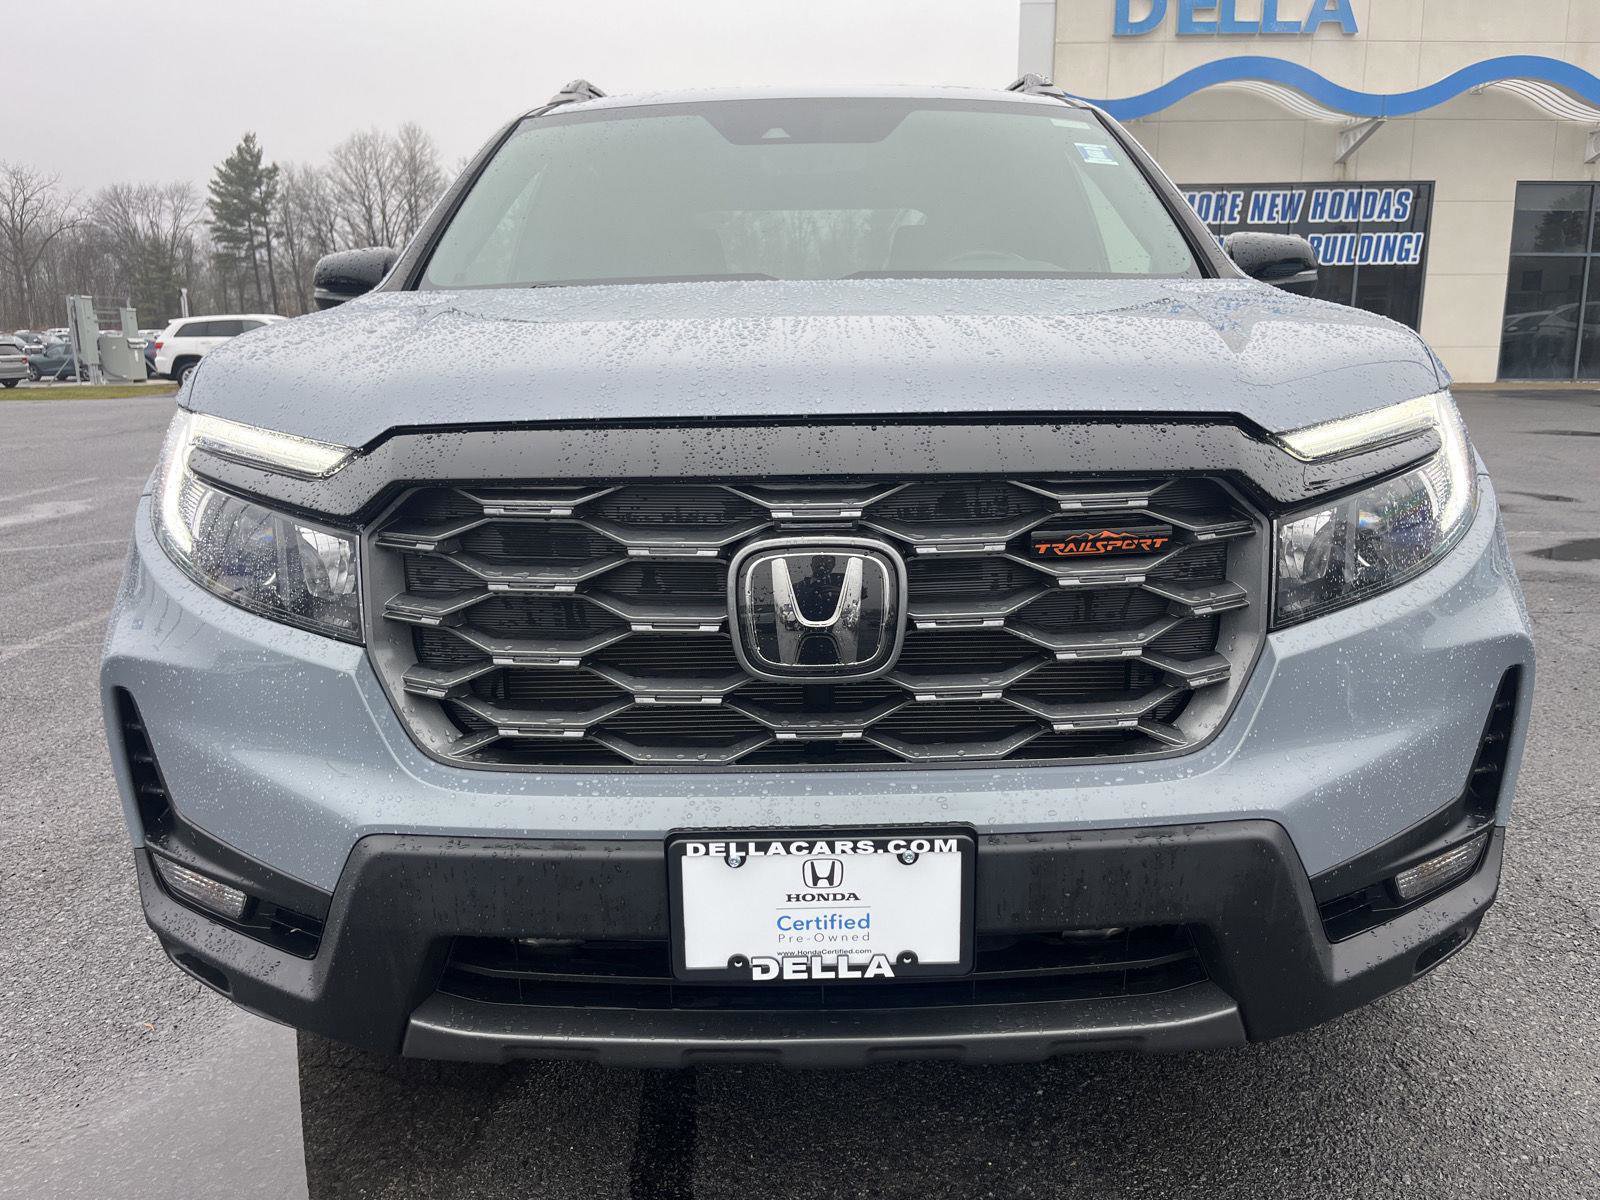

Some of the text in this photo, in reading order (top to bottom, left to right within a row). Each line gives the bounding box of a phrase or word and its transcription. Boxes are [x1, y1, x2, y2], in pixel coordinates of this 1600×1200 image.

[1112, 0, 1359, 37] DELLA
[1247, 190, 1306, 224] NEW
[1308, 188, 1412, 223] HONDAS
[1034, 538, 1168, 555] TRAILSPORT
[686, 839, 958, 857] DELLACARS.COM
[786, 892, 861, 902] HONDA
[776, 912, 871, 931] Certified
[778, 932, 870, 943] Pre-Owned
[777, 948, 872, 956] www.HondaCertified.com
[752, 955, 895, 981] DELLA
